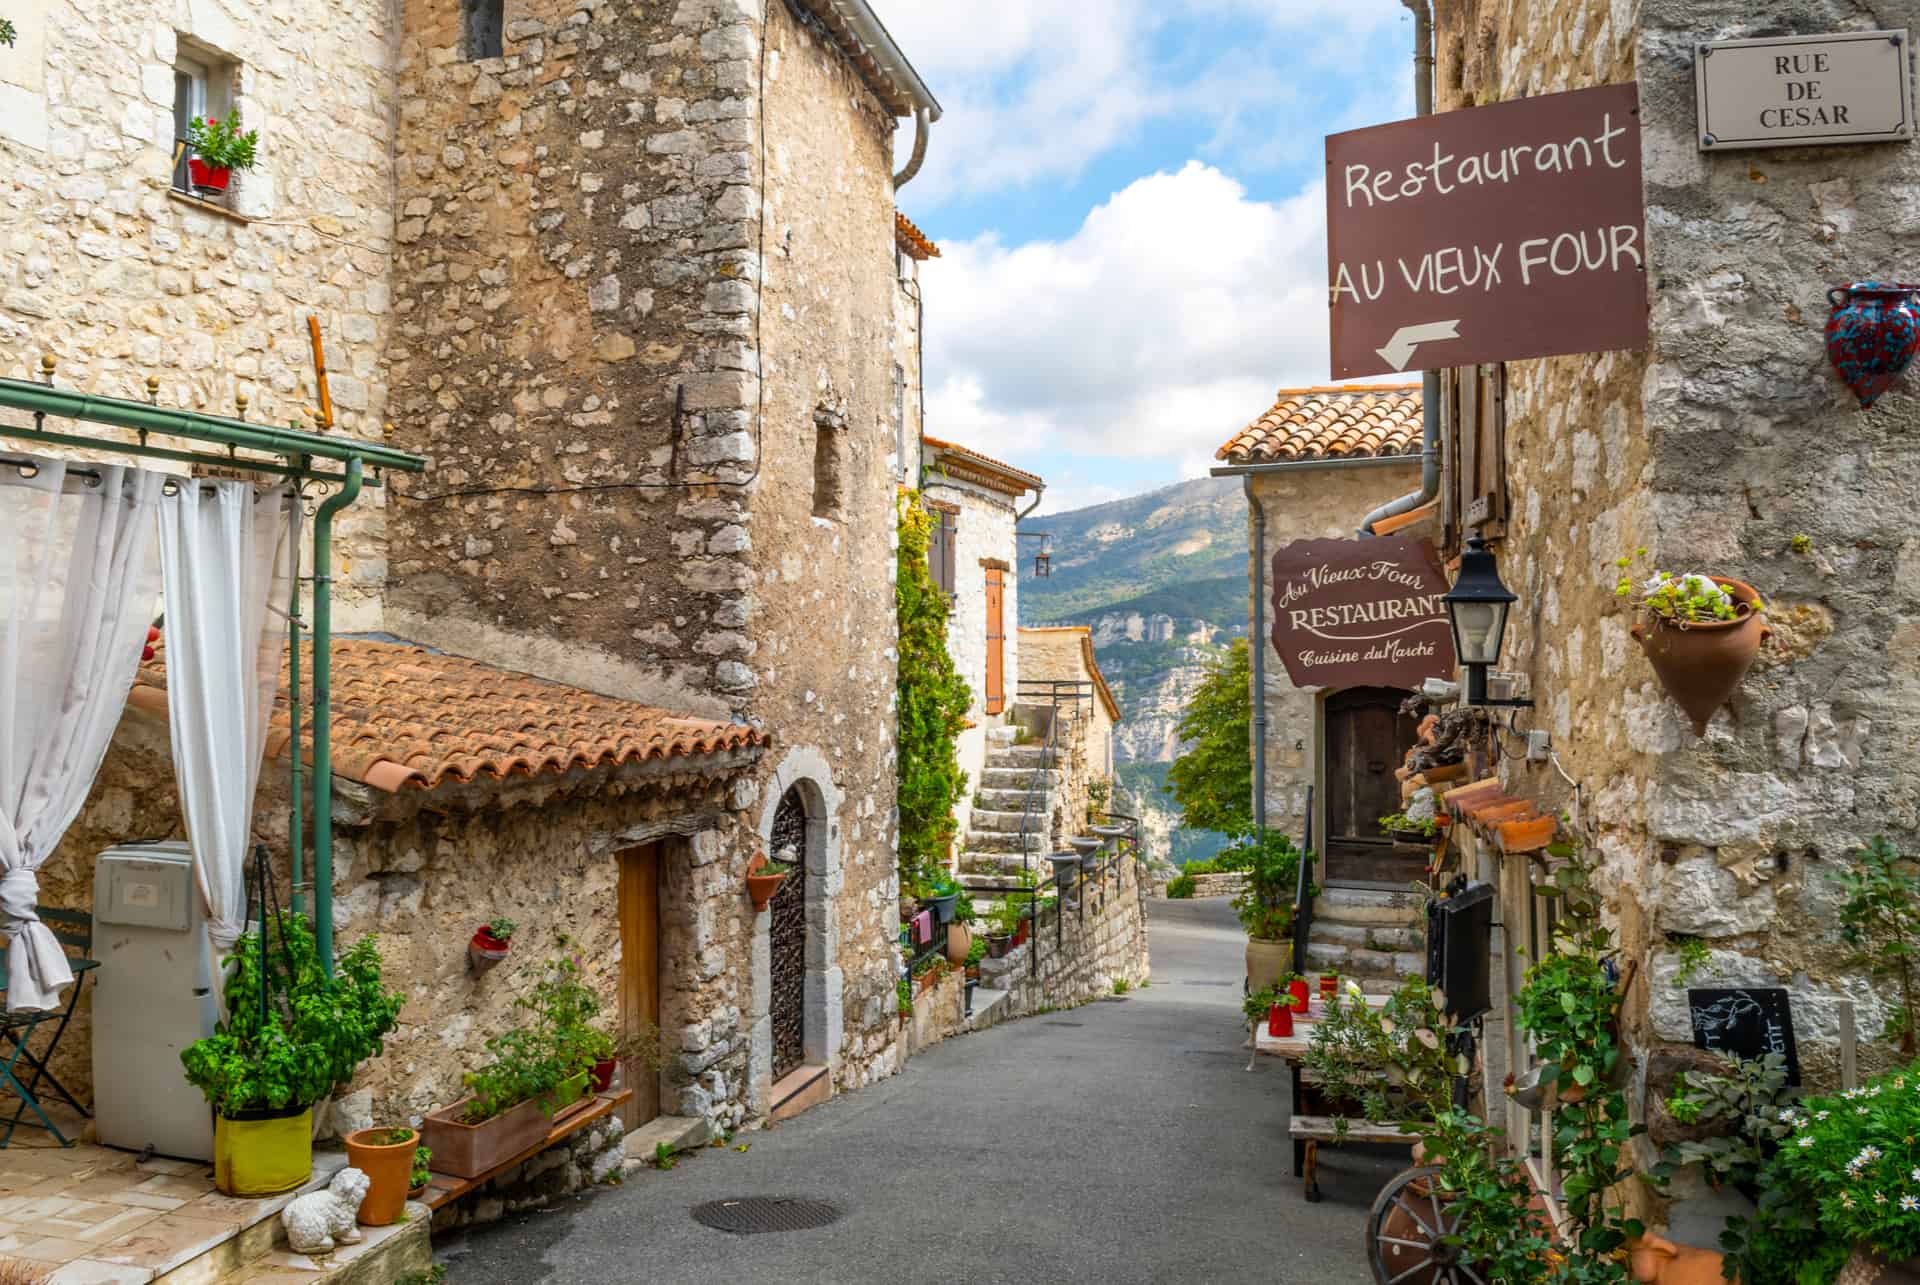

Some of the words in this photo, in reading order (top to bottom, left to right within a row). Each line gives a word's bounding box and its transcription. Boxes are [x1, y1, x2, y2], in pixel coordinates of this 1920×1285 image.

[1775, 53, 1830, 75] RUE
[1787, 81, 1822, 101] DE
[1760, 105, 1849, 128] CESAR
[1345, 113, 1627, 207] Restaurant
[1330, 260, 1385, 304] AU
[1398, 243, 1504, 294] VIEUX
[1519, 225, 1643, 285] FOUR
[1279, 581, 1309, 608] Au
[1303, 564, 1368, 589] Vieux
[1367, 560, 1425, 589] Four
[1289, 592, 1449, 630] RESTAURANT
[1298, 649, 1360, 667] Cuisine
[1364, 645, 1383, 661] du
[1382, 639, 1436, 664] Marché
